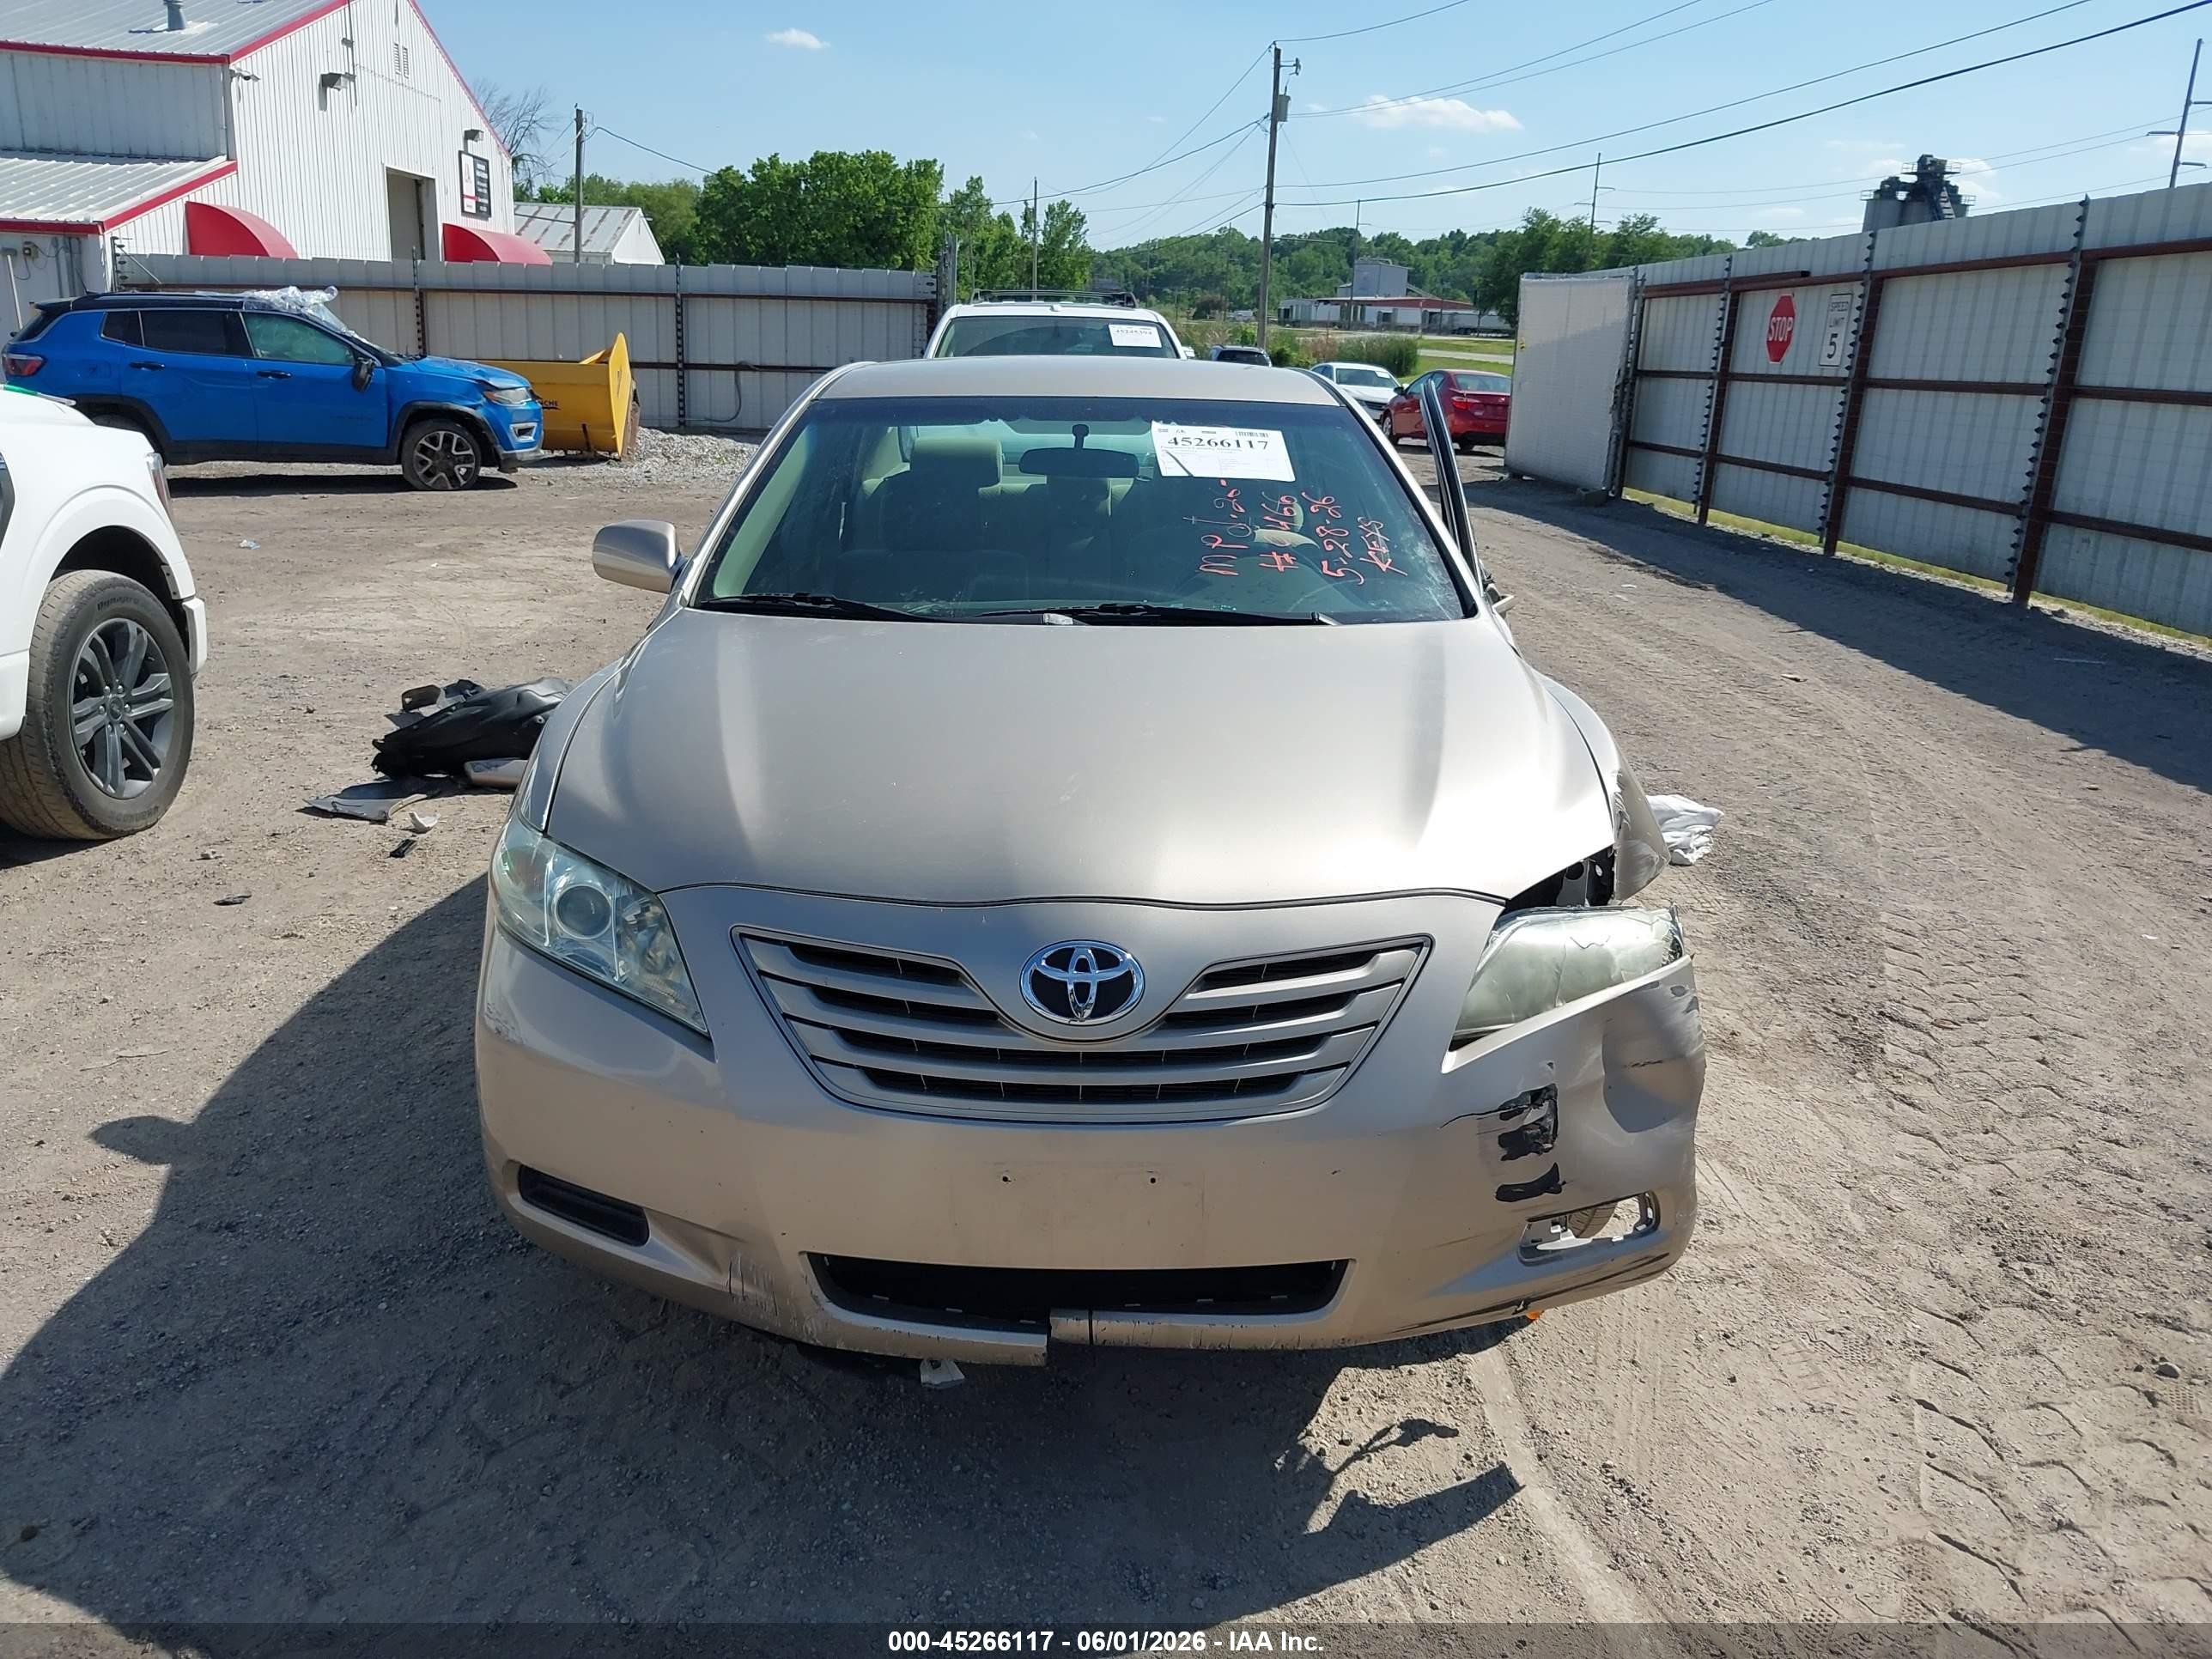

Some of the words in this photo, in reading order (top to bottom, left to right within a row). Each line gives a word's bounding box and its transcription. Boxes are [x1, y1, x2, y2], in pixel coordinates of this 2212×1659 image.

[1768, 316, 1794, 342] STOP
[1826, 332, 1838, 359] 5
[1167, 436, 1269, 450] 45266117
[1358, 517, 1408, 576] KEYS
